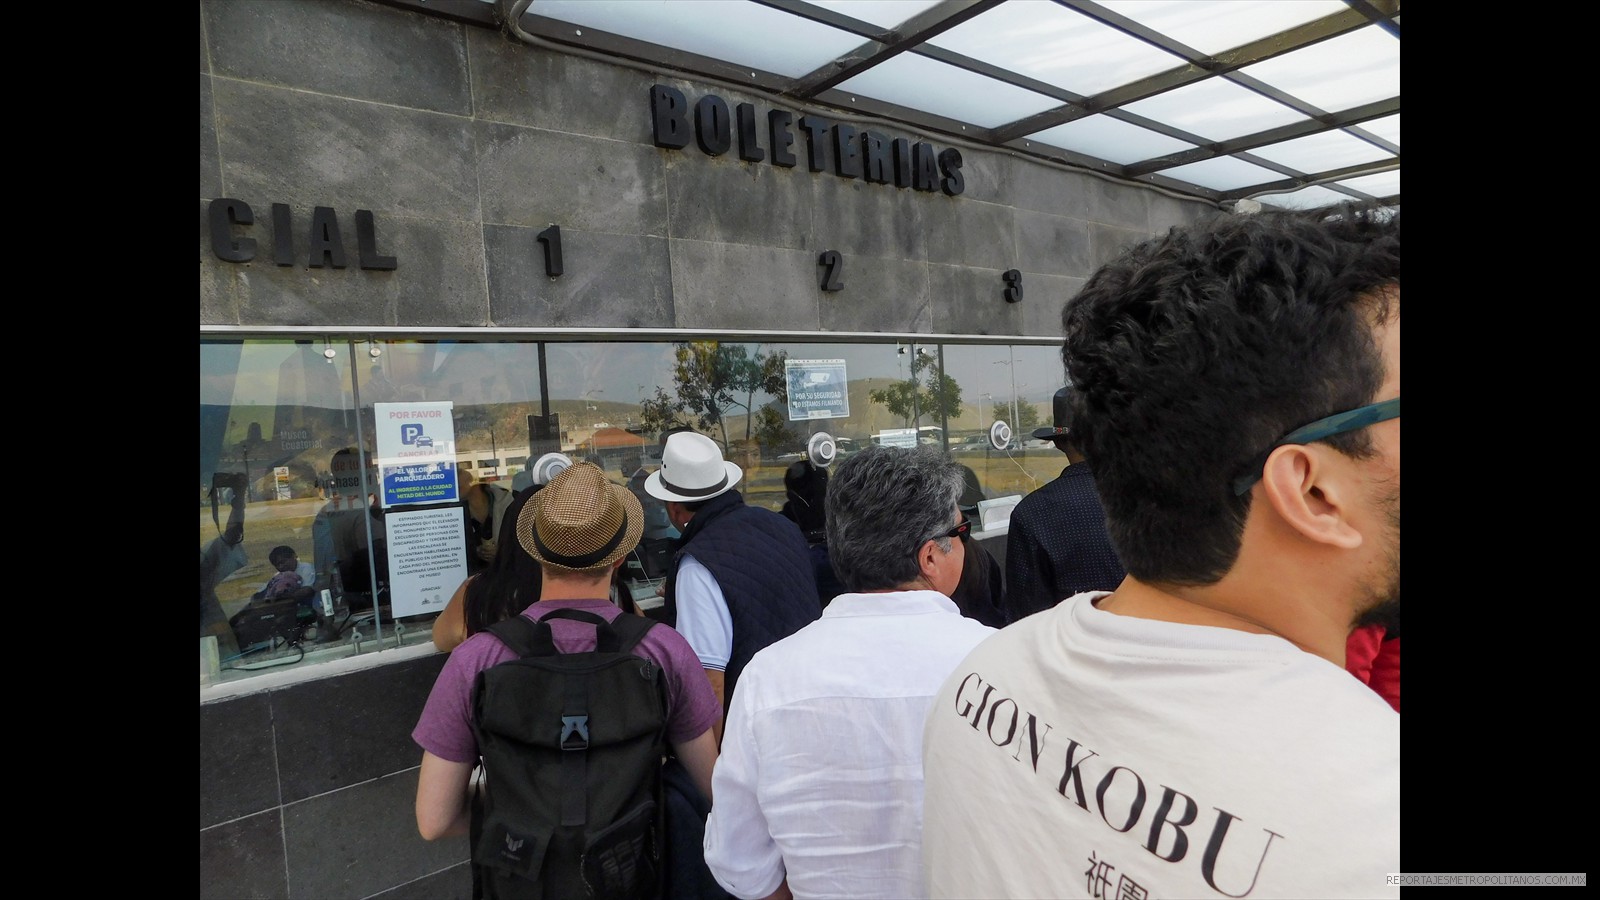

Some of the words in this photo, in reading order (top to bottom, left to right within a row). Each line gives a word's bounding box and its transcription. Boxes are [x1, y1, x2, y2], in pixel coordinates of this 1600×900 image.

[650, 84, 965, 197] BOLETERIAS
[208, 197, 398, 271] CIAL
[536, 223, 564, 277] 1
[818, 249, 844, 292] 2
[1002, 268, 1023, 303] 3
[795, 392, 806, 400] POR
[813, 391, 842, 399] SEGURIDAD
[802, 400, 821, 408] ESTAMOS
[821, 399, 843, 407] FILMANDO
[389, 411, 410, 420] POR
[411, 410, 442, 418] FAVOR
[394, 473, 445, 483] PARQUEADERO
[397, 466, 405, 474] EL
[405, 466, 428, 474] VALOR
[955, 672, 1053, 774] GION
[1055, 738, 1285, 899] KOBU
